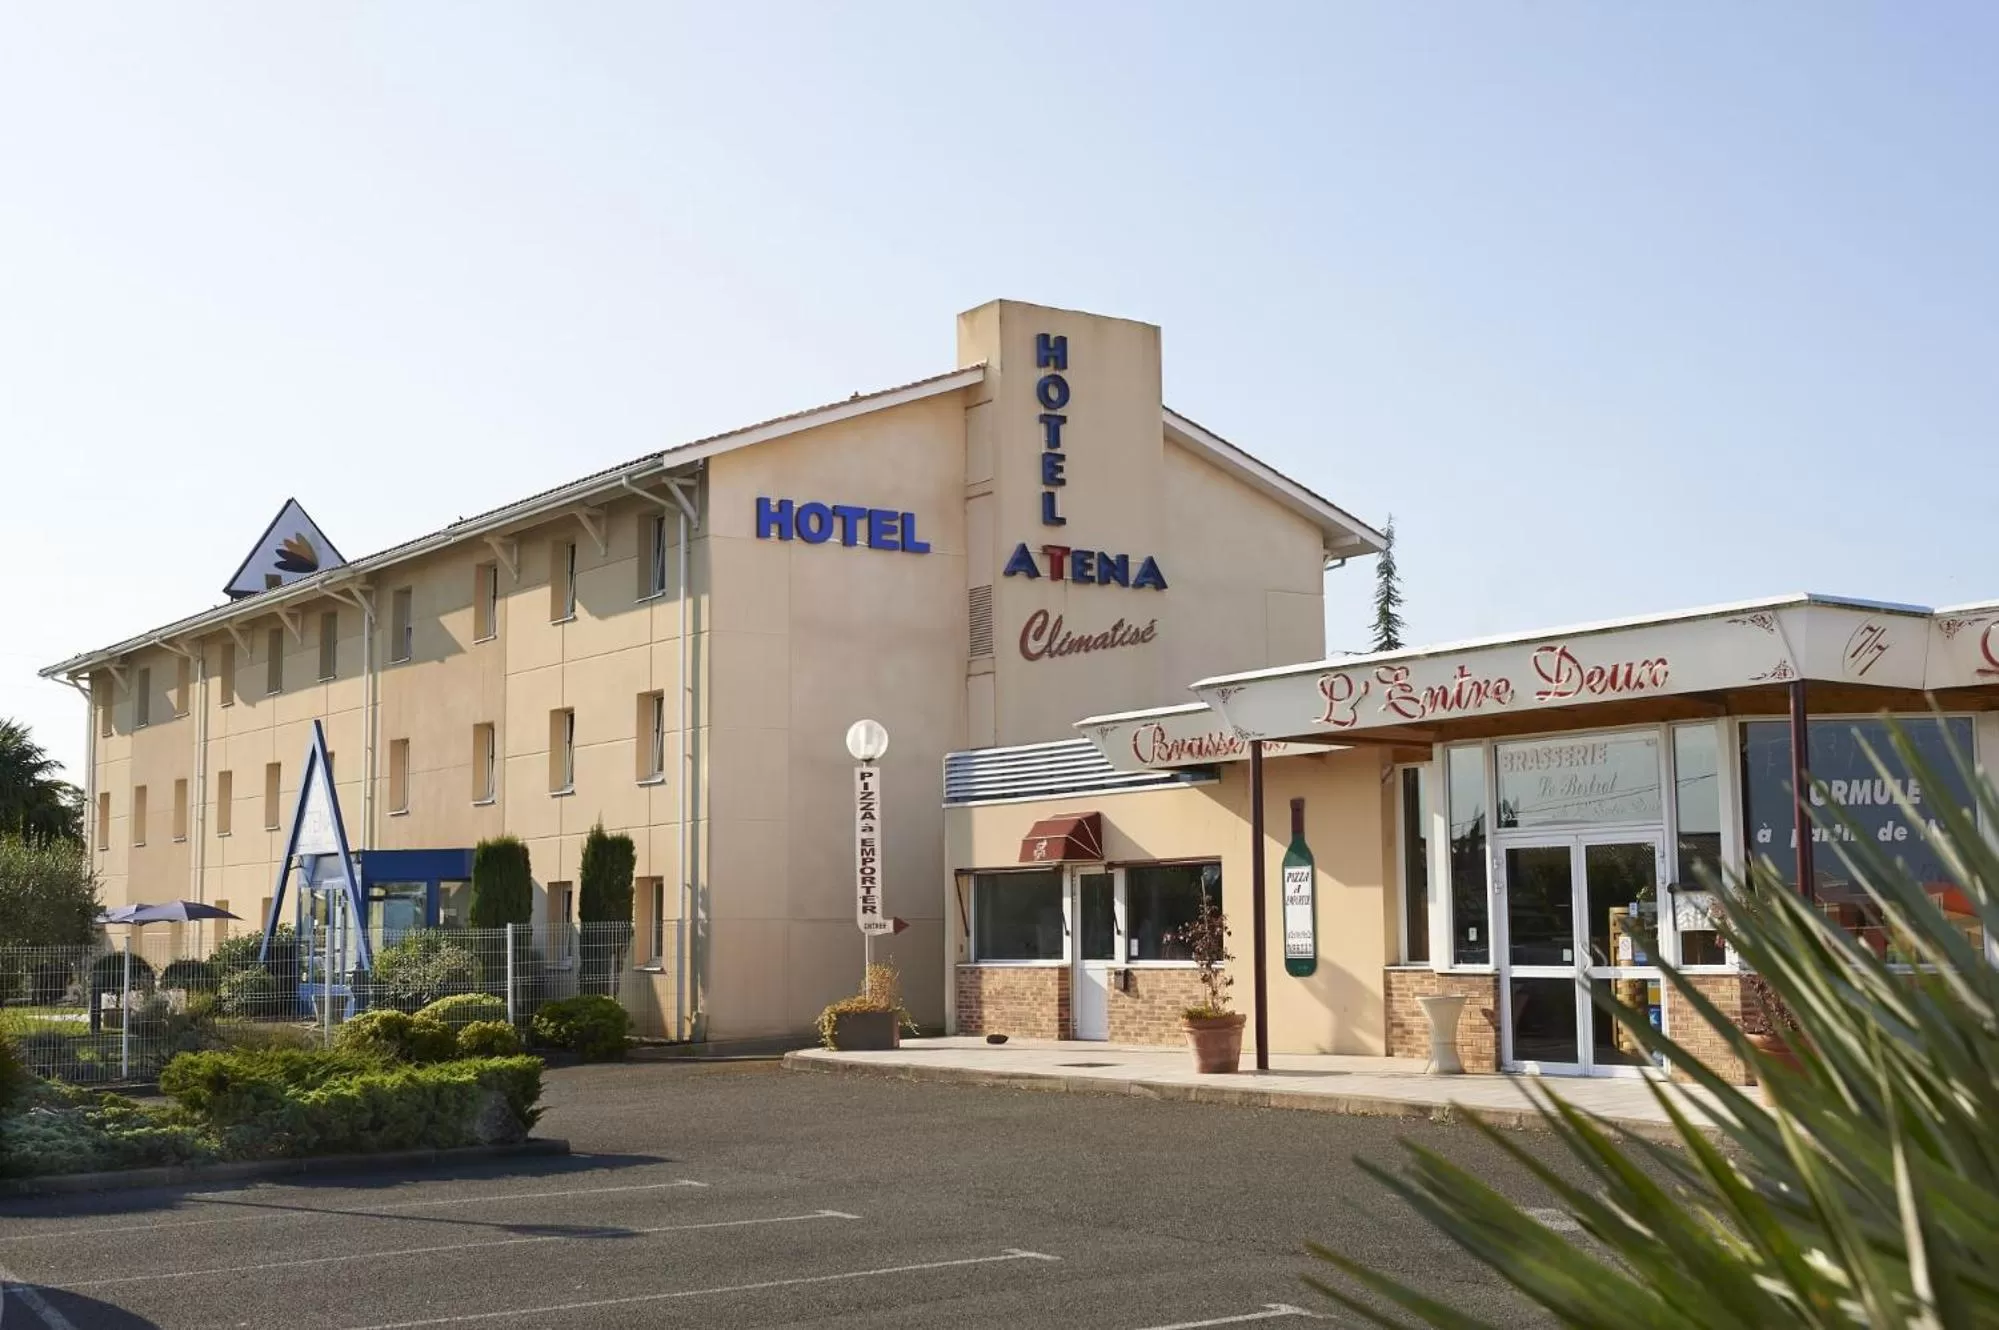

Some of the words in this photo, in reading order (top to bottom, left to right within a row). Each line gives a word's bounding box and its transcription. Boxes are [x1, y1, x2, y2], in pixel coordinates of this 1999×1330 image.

[1036, 333, 1070, 526] HOTEL
[756, 497, 931, 554] HOTEL
[1003, 542, 1168, 591] ATENA
[1019, 608, 1158, 662] Climatisé
[1533, 645, 1669, 701] Deux
[1503, 742, 1608, 773] BRASSERIE
[859, 771, 877, 821] PIZZA
[1809, 778, 1921, 807] ORMULE
[1756, 822, 1773, 844] à
[1877, 820, 1908, 842] de
[859, 837, 878, 915] EMPORTER
